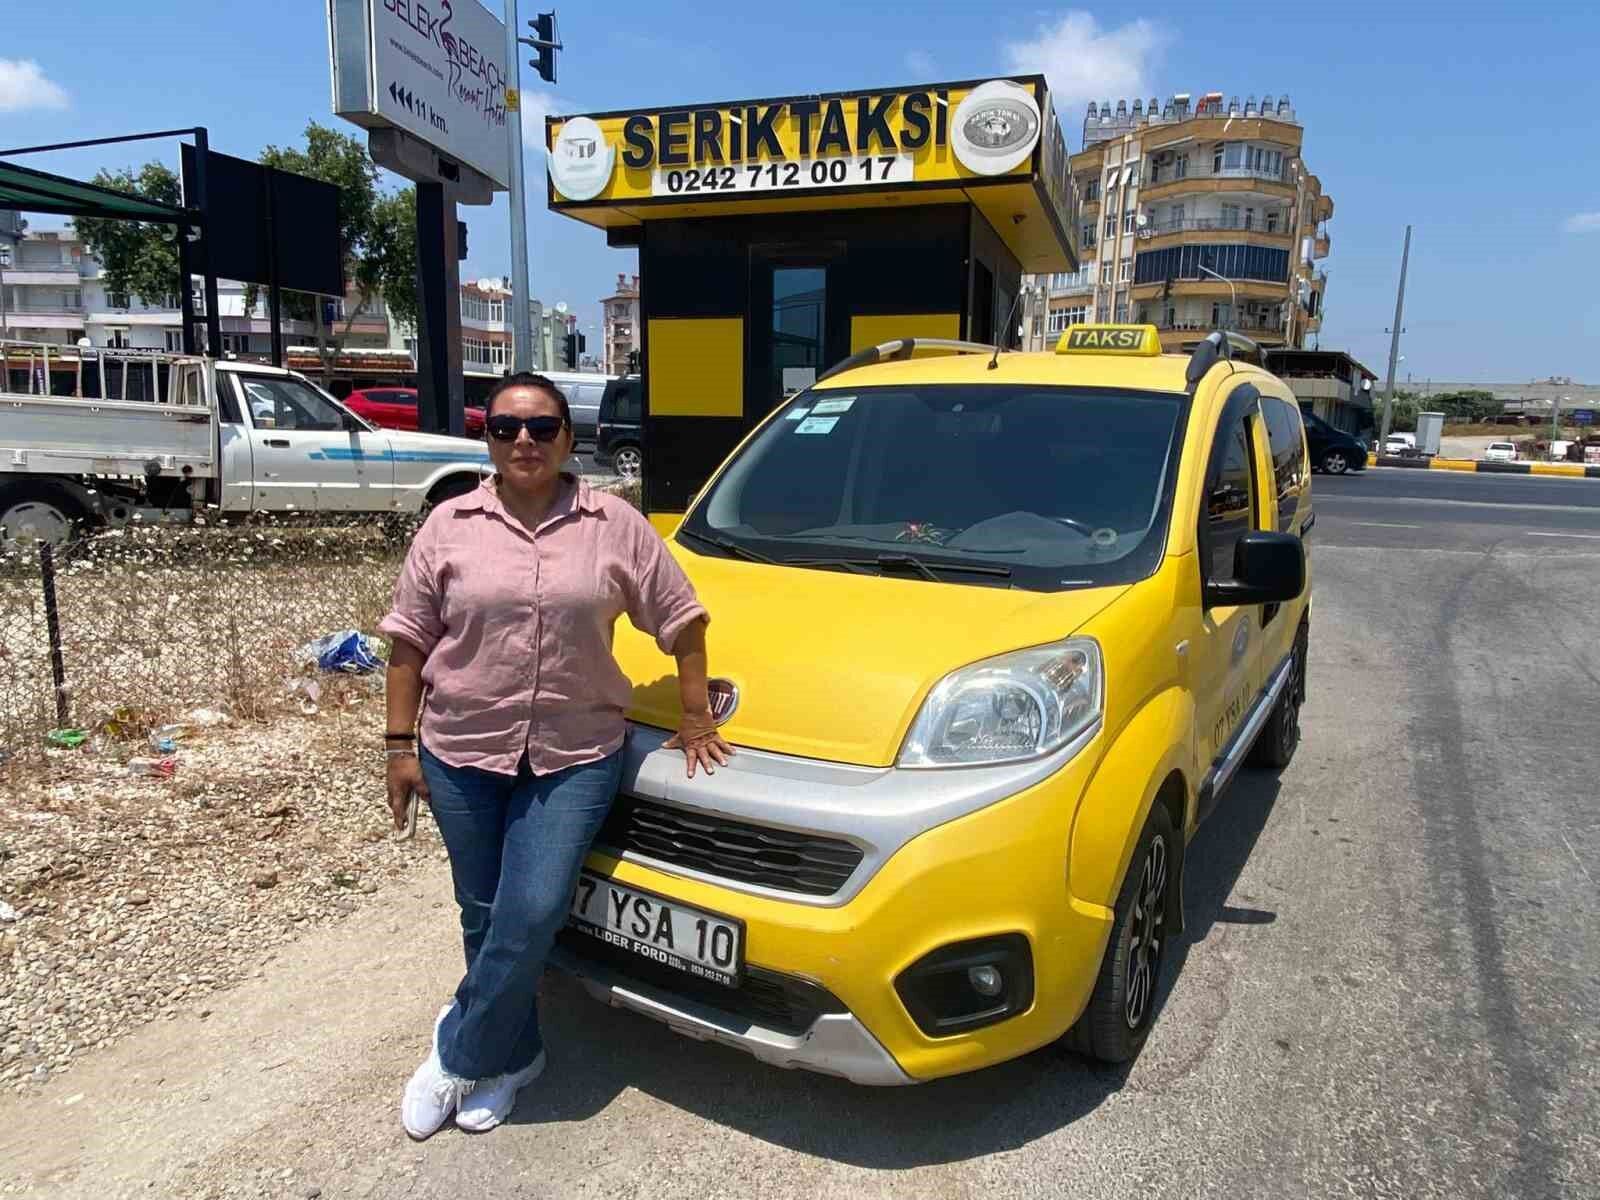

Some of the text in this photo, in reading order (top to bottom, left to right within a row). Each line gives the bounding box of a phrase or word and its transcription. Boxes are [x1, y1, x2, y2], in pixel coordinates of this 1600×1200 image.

[459, 36, 507, 97] BEACH
[415, 98, 449, 135] 11 km.
[667, 156, 896, 193] 0242 712 00 17
[573, 878, 597, 915] 7
[609, 887, 675, 950] YSA
[695, 919, 734, 968] 10
[633, 941, 668, 965] FORD
